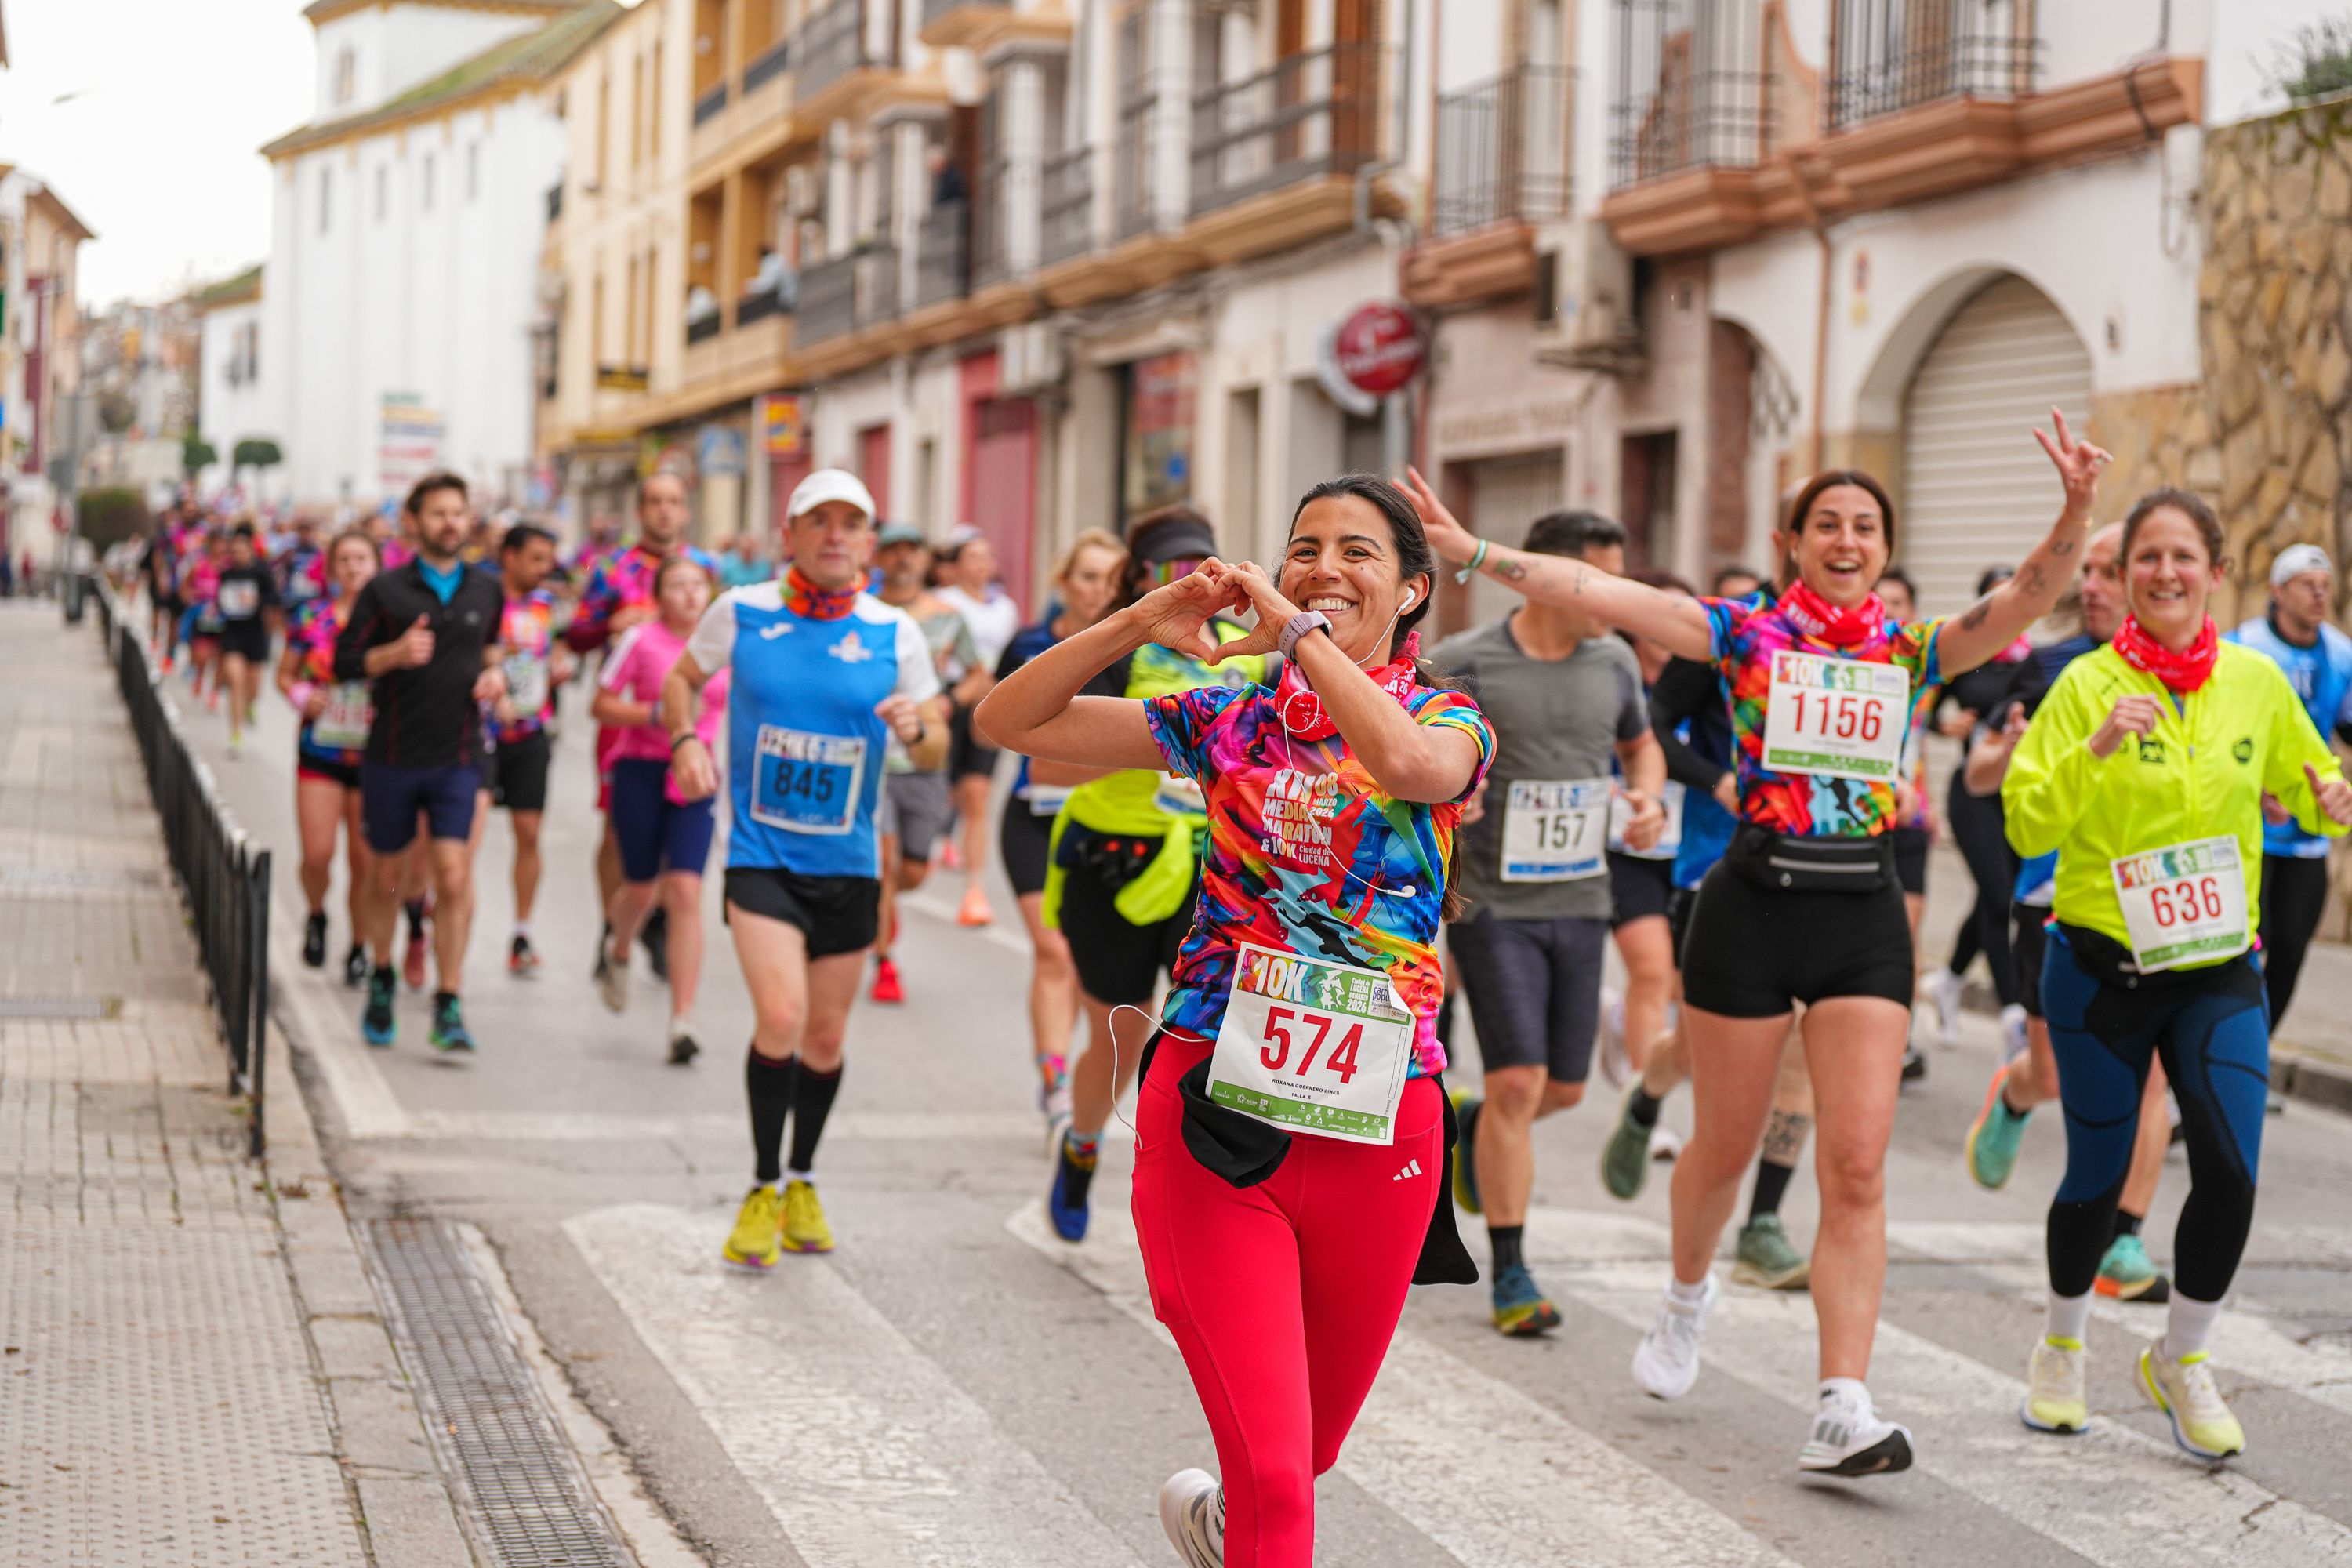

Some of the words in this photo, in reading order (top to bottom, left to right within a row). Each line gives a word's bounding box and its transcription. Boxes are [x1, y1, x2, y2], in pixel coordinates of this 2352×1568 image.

[1792, 691, 1884, 741] 1156
[773, 760, 834, 803] 845
[1315, 772, 1338, 797] 08
[1262, 798, 1310, 822] MEDIA
[1309, 807, 1334, 818] 2026
[1312, 798, 1338, 807] MARZO
[1535, 814, 1587, 849] 157
[1261, 838, 1270, 852] &
[1272, 836, 1297, 860] 10K
[1298, 853, 1330, 866] LUCENA
[1299, 844, 1322, 855] Ciudad
[1323, 846, 1330, 856] de
[2151, 877, 2221, 927] 636
[1253, 955, 1310, 1003] 10K
[1374, 986, 1389, 995] carr
[1346, 998, 1367, 1014] 2026
[1372, 992, 1390, 1003] popu
[1259, 1006, 1363, 1084] 574
[1272, 1078, 1294, 1087] ROXANA
[1294, 1083, 1323, 1093] GUERRERO
